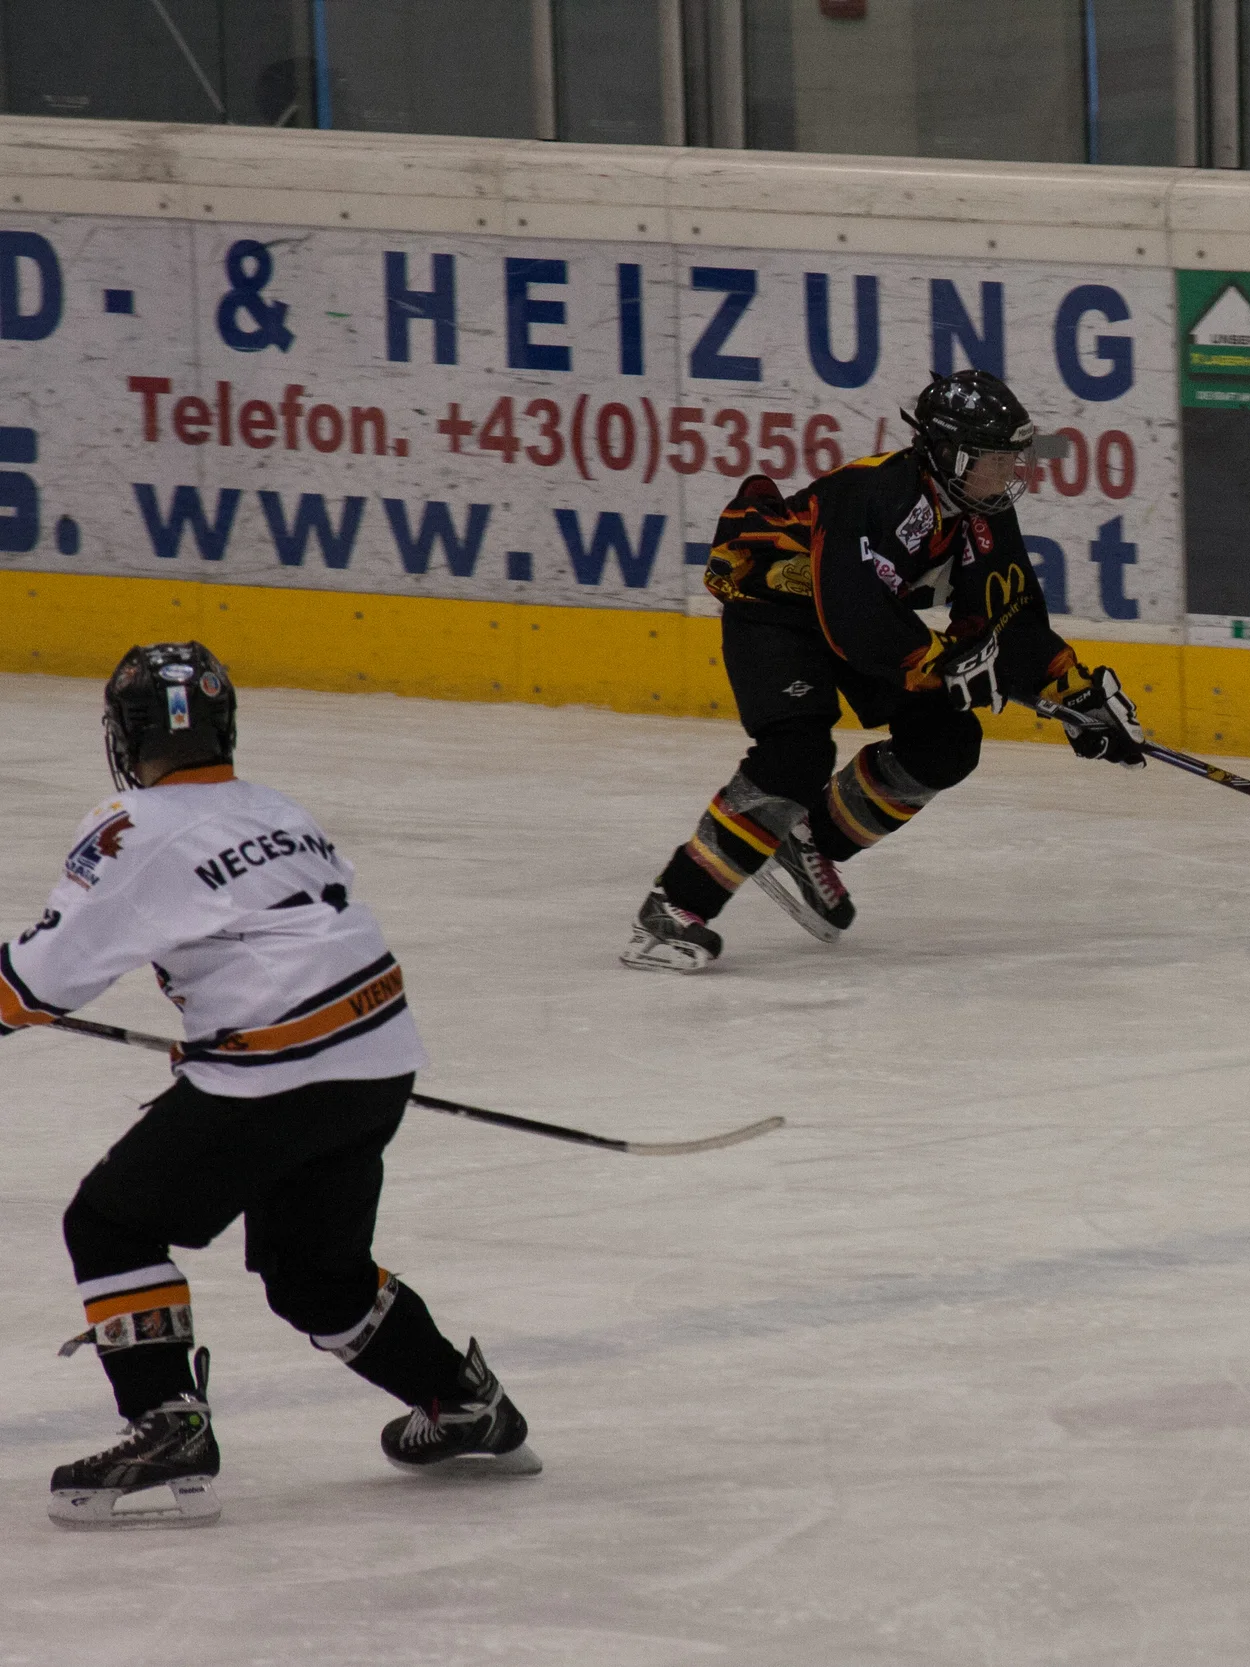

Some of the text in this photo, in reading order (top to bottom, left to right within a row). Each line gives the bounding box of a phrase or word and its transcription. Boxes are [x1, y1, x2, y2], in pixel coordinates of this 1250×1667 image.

[216, 238, 297, 353] &
[382, 249, 1135, 402] HEIZUNG
[127, 375, 411, 458] Telefon.
[437, 393, 843, 484] +43(0)5356
